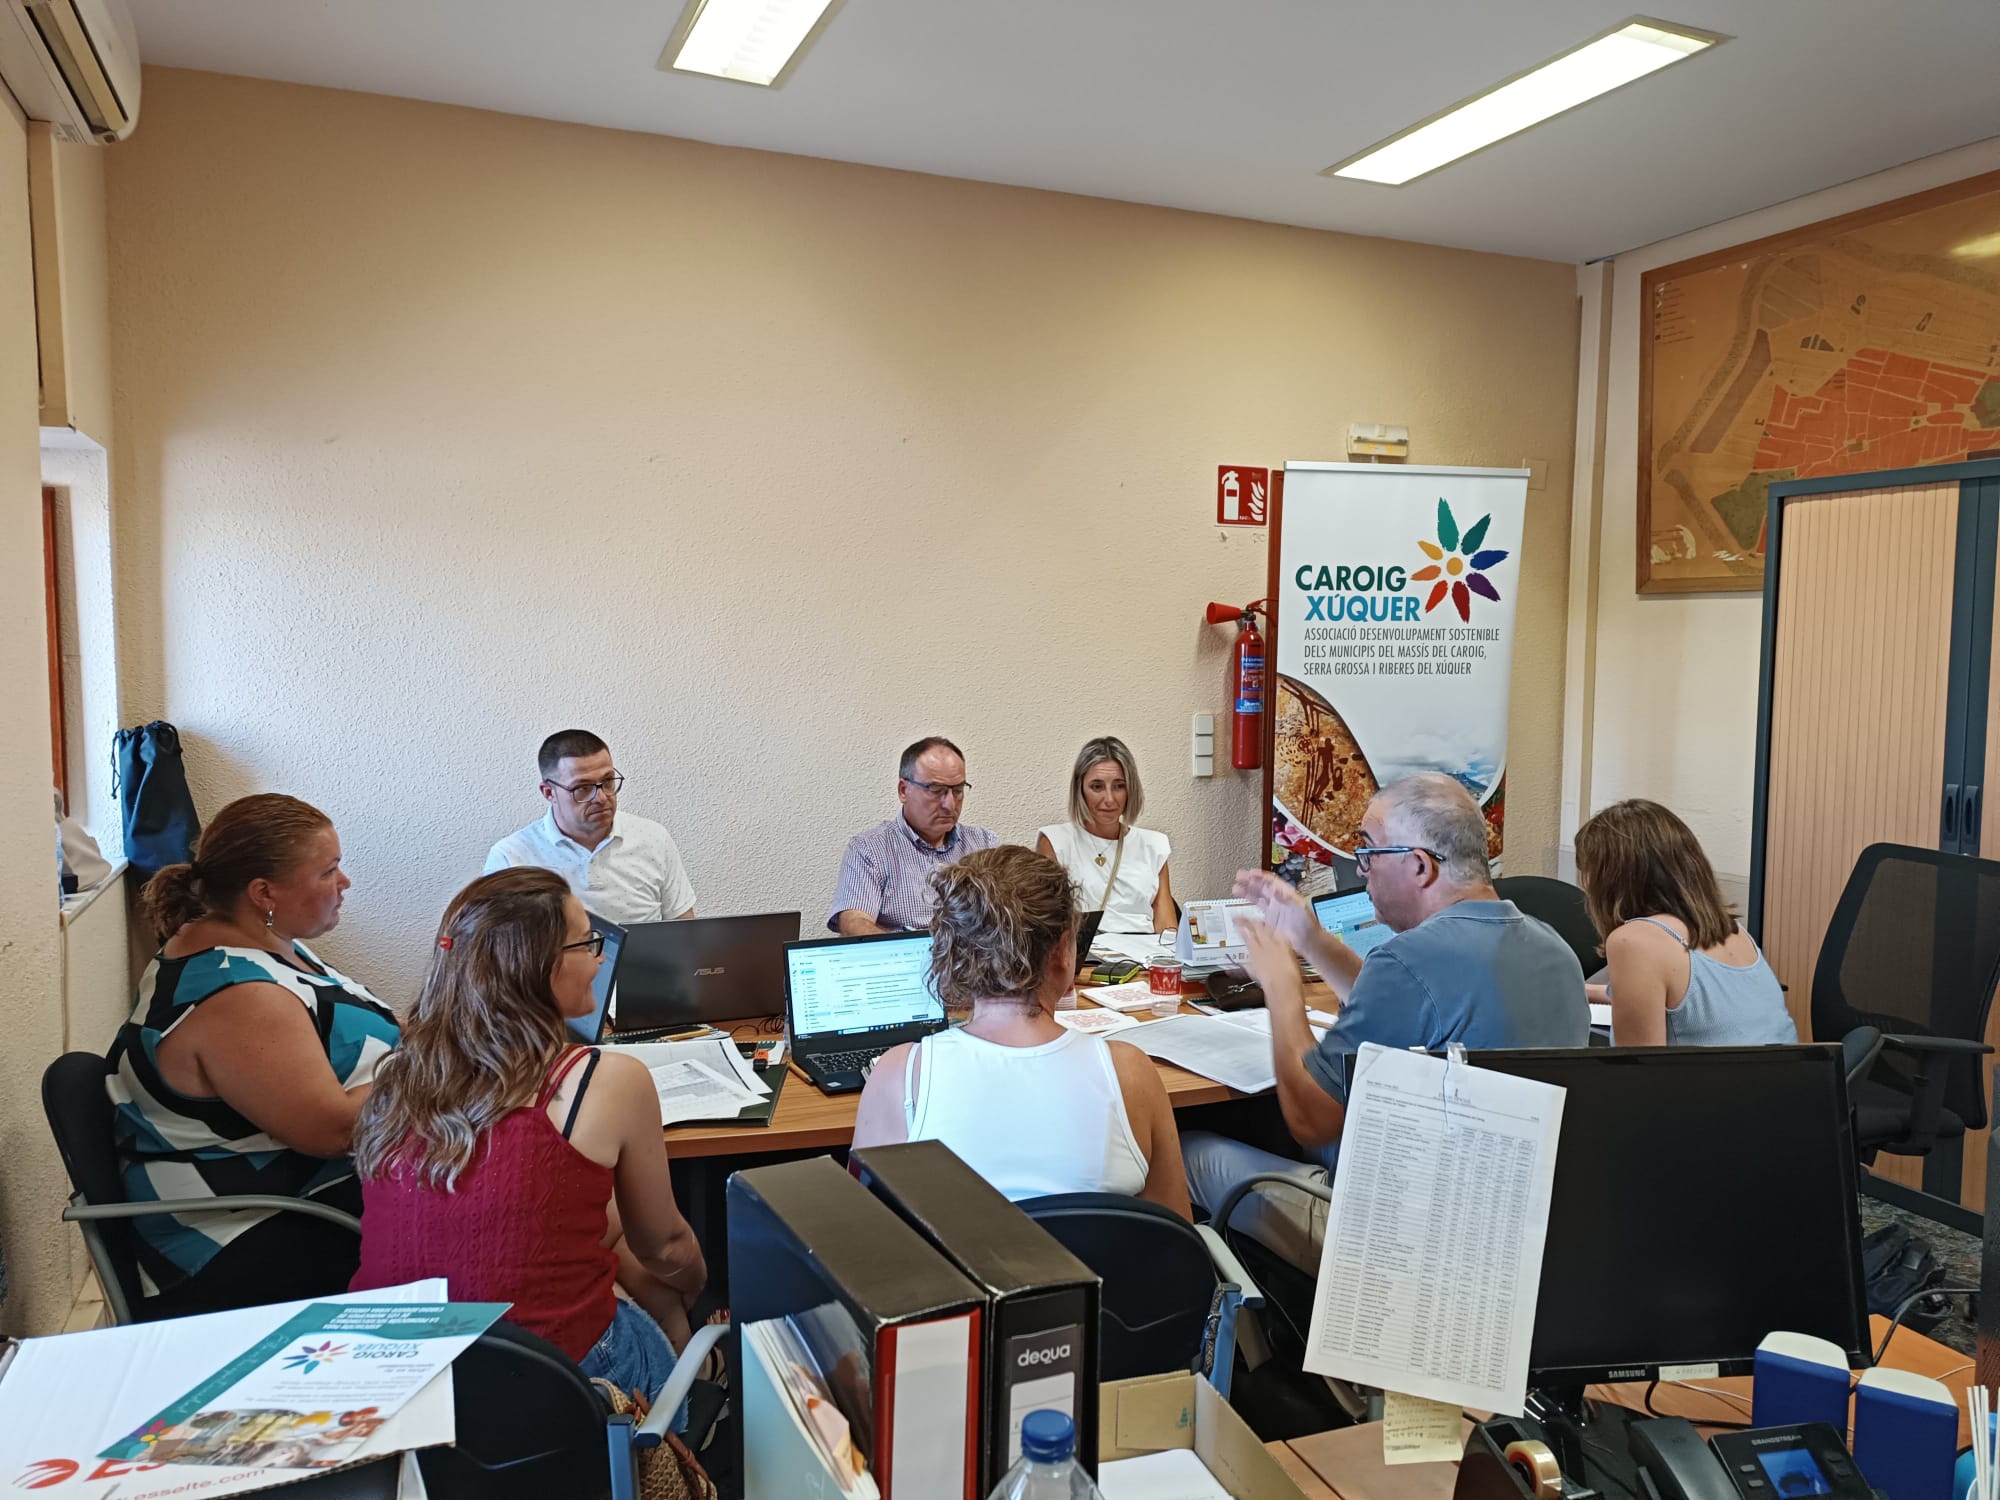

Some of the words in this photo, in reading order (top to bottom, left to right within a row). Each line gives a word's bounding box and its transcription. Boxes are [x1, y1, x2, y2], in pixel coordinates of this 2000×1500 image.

[1296, 565, 1407, 592] CAROIG
[1304, 593, 1421, 622] XÚQUER
[1304, 625, 1357, 641] ASSOCIACIÓ
[1360, 628, 1446, 641] DESENVOLUPAMENT
[1449, 628, 1500, 641] SOSTENIBLE
[1304, 645, 1327, 658] DELS
[1329, 645, 1375, 658] MUNICIPIS
[1378, 645, 1395, 658] DEL
[1397, 642, 1430, 658] MASSÍS
[1432, 645, 1448, 658] DEL
[1451, 645, 1487, 660] CAROIG,
[1304, 662, 1332, 675] SERRA
[1334, 662, 1370, 675] GROSSA
[1379, 662, 1415, 675] RIBERES
[1417, 662, 1433, 675] DEL
[1435, 660, 1472, 675] XÚQUER
[693, 967, 725, 976] ASUS
[1017, 1344, 1071, 1367] dequa
[1608, 1369, 1646, 1379] SAMSUNG
